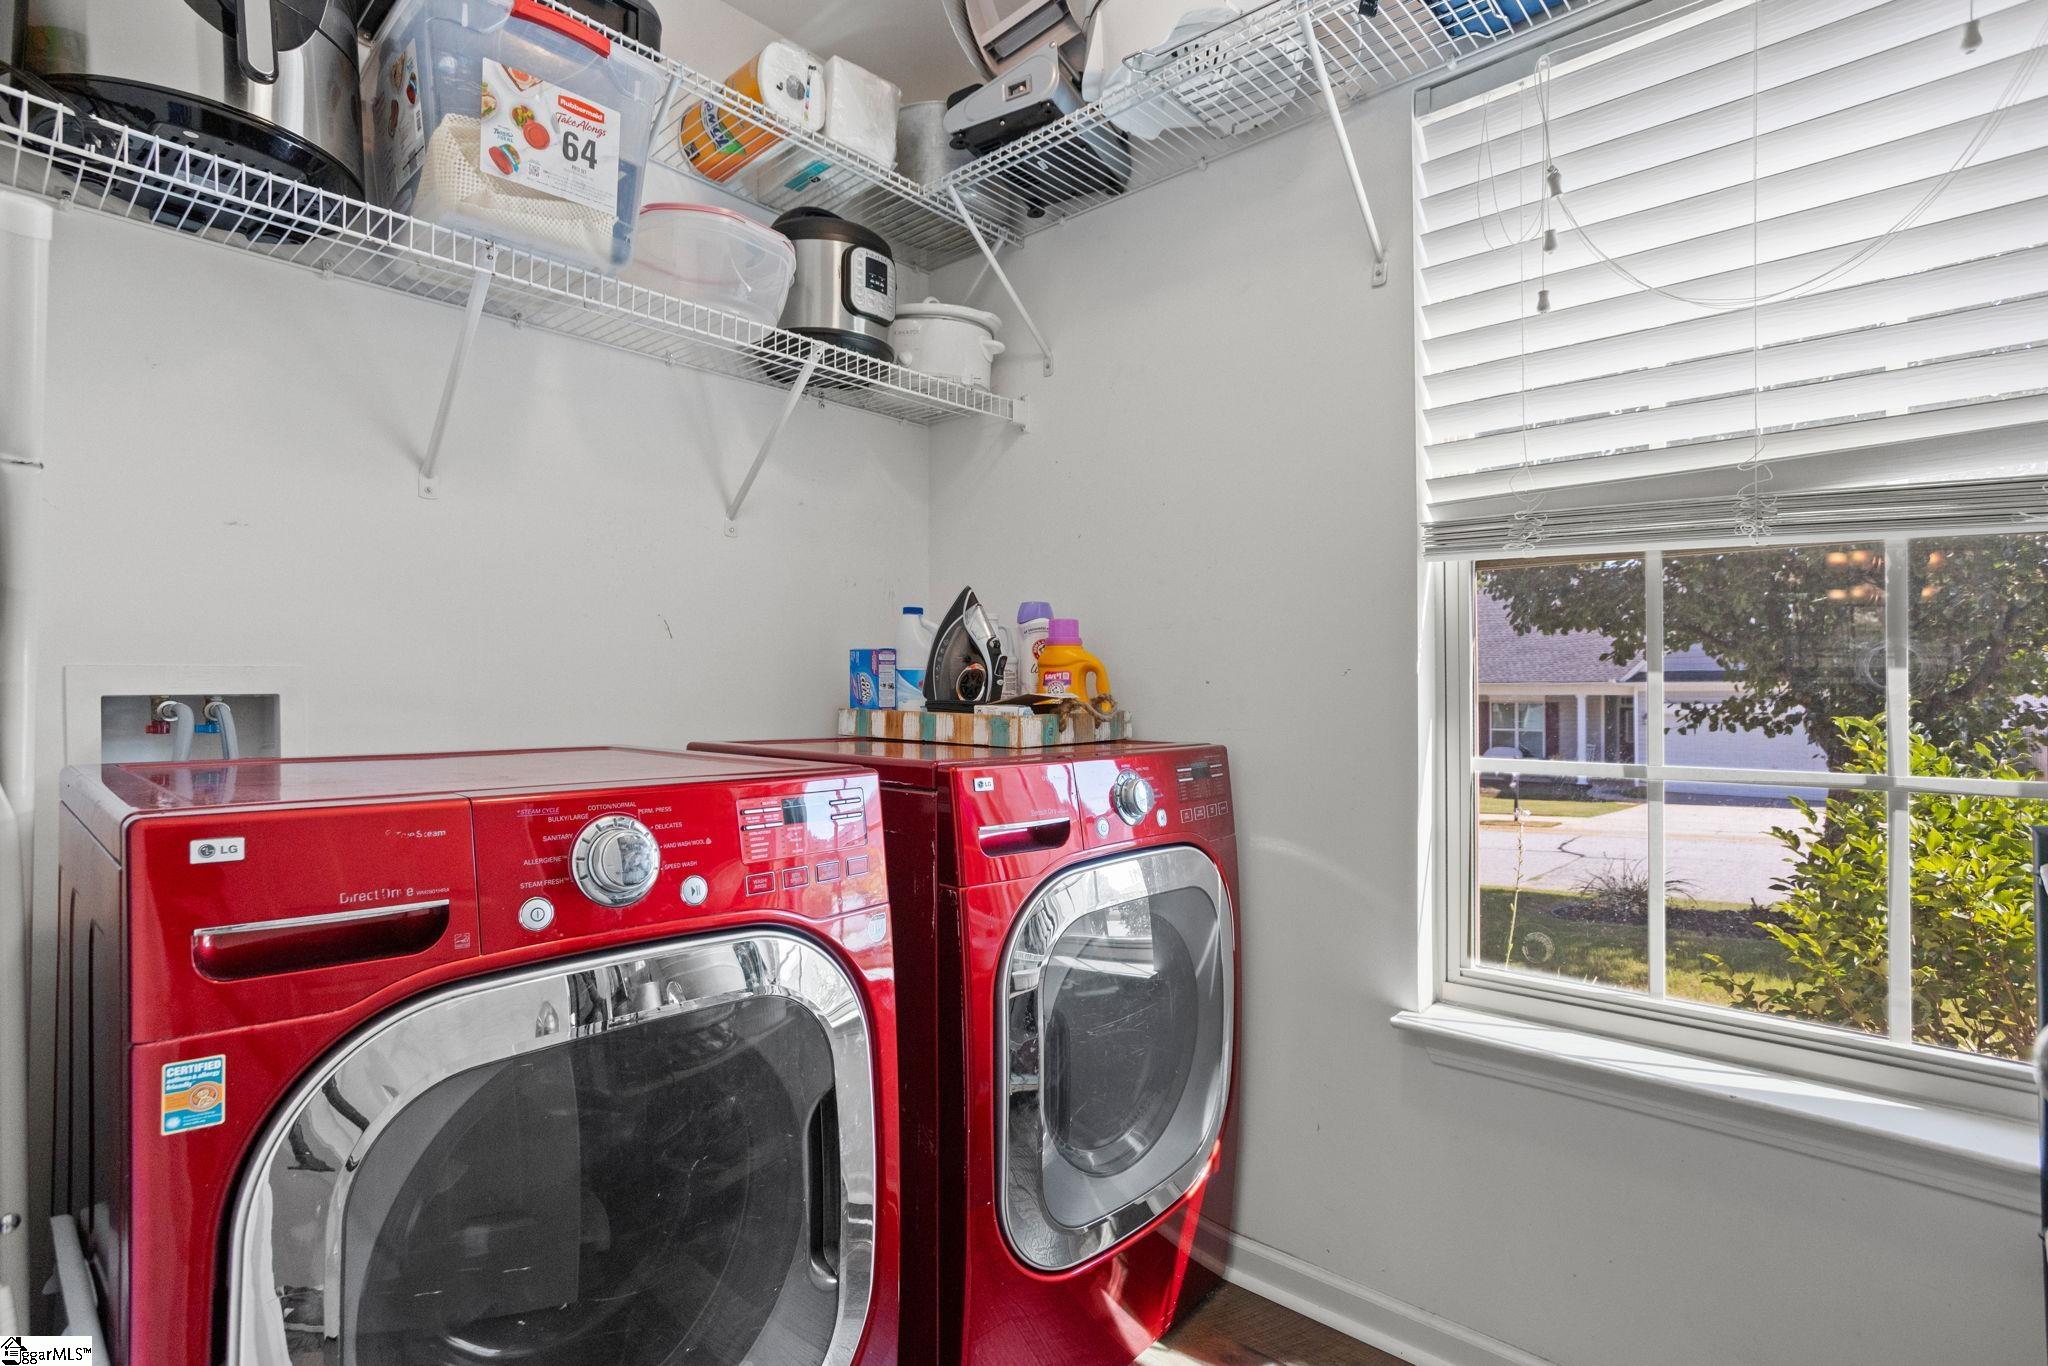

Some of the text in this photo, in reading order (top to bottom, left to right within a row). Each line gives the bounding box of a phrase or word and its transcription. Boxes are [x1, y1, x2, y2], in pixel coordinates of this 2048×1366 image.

[560, 98, 603, 121] Rubbermaid
[562, 131, 597, 170] 64
[587, 801, 637, 811] COTTON/NORMAL
[547, 813, 589, 823] BULKY/LARGE
[654, 821, 683, 830] DELICATES
[542, 833, 573, 842] SANITARY
[220, 844, 239, 855] LG
[664, 860, 698, 871] SPEED WASH
[520, 880, 543, 890] STEAM
[166, 1060, 222, 1078] CERTIFIED
